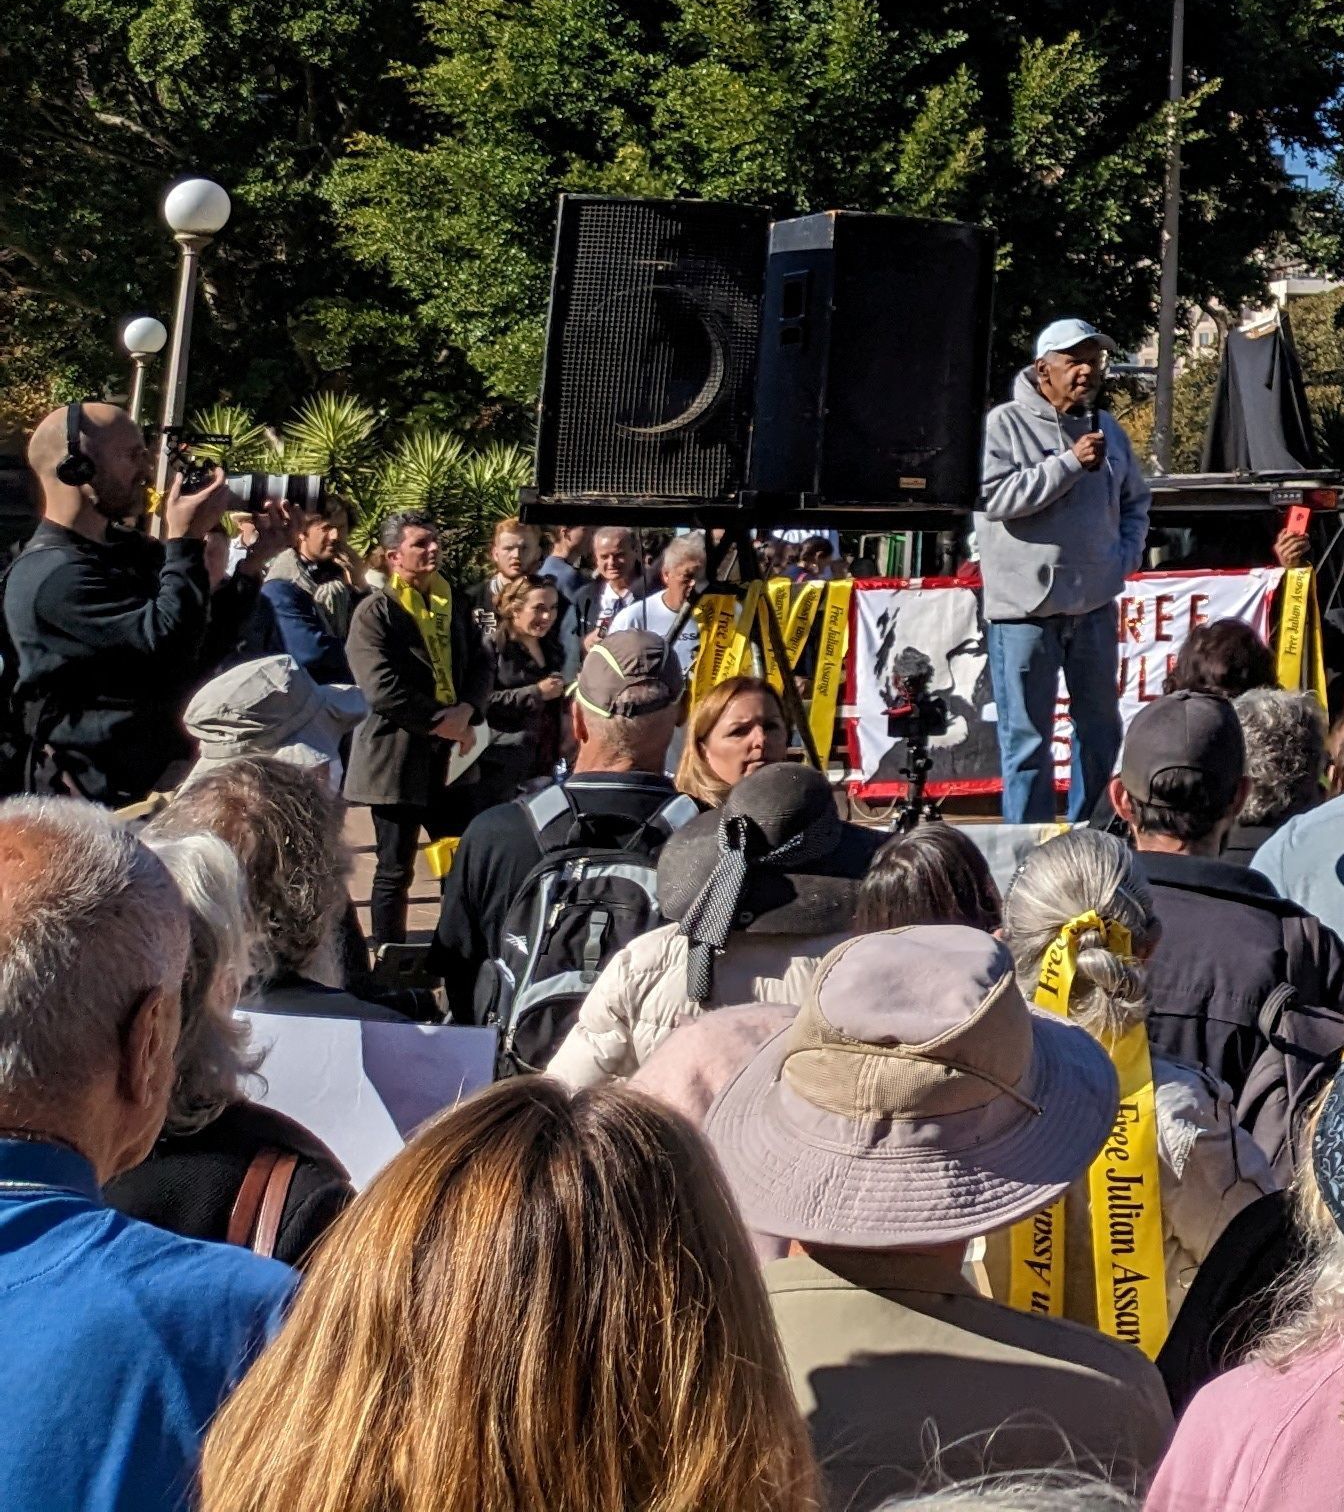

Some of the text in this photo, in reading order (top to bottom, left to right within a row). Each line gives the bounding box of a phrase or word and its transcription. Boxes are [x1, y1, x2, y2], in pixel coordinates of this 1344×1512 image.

[716, 610, 735, 640] Free
[817, 604, 844, 697] Free Julian Assange
[1105, 1101, 1150, 1346] Free Julian Assan
